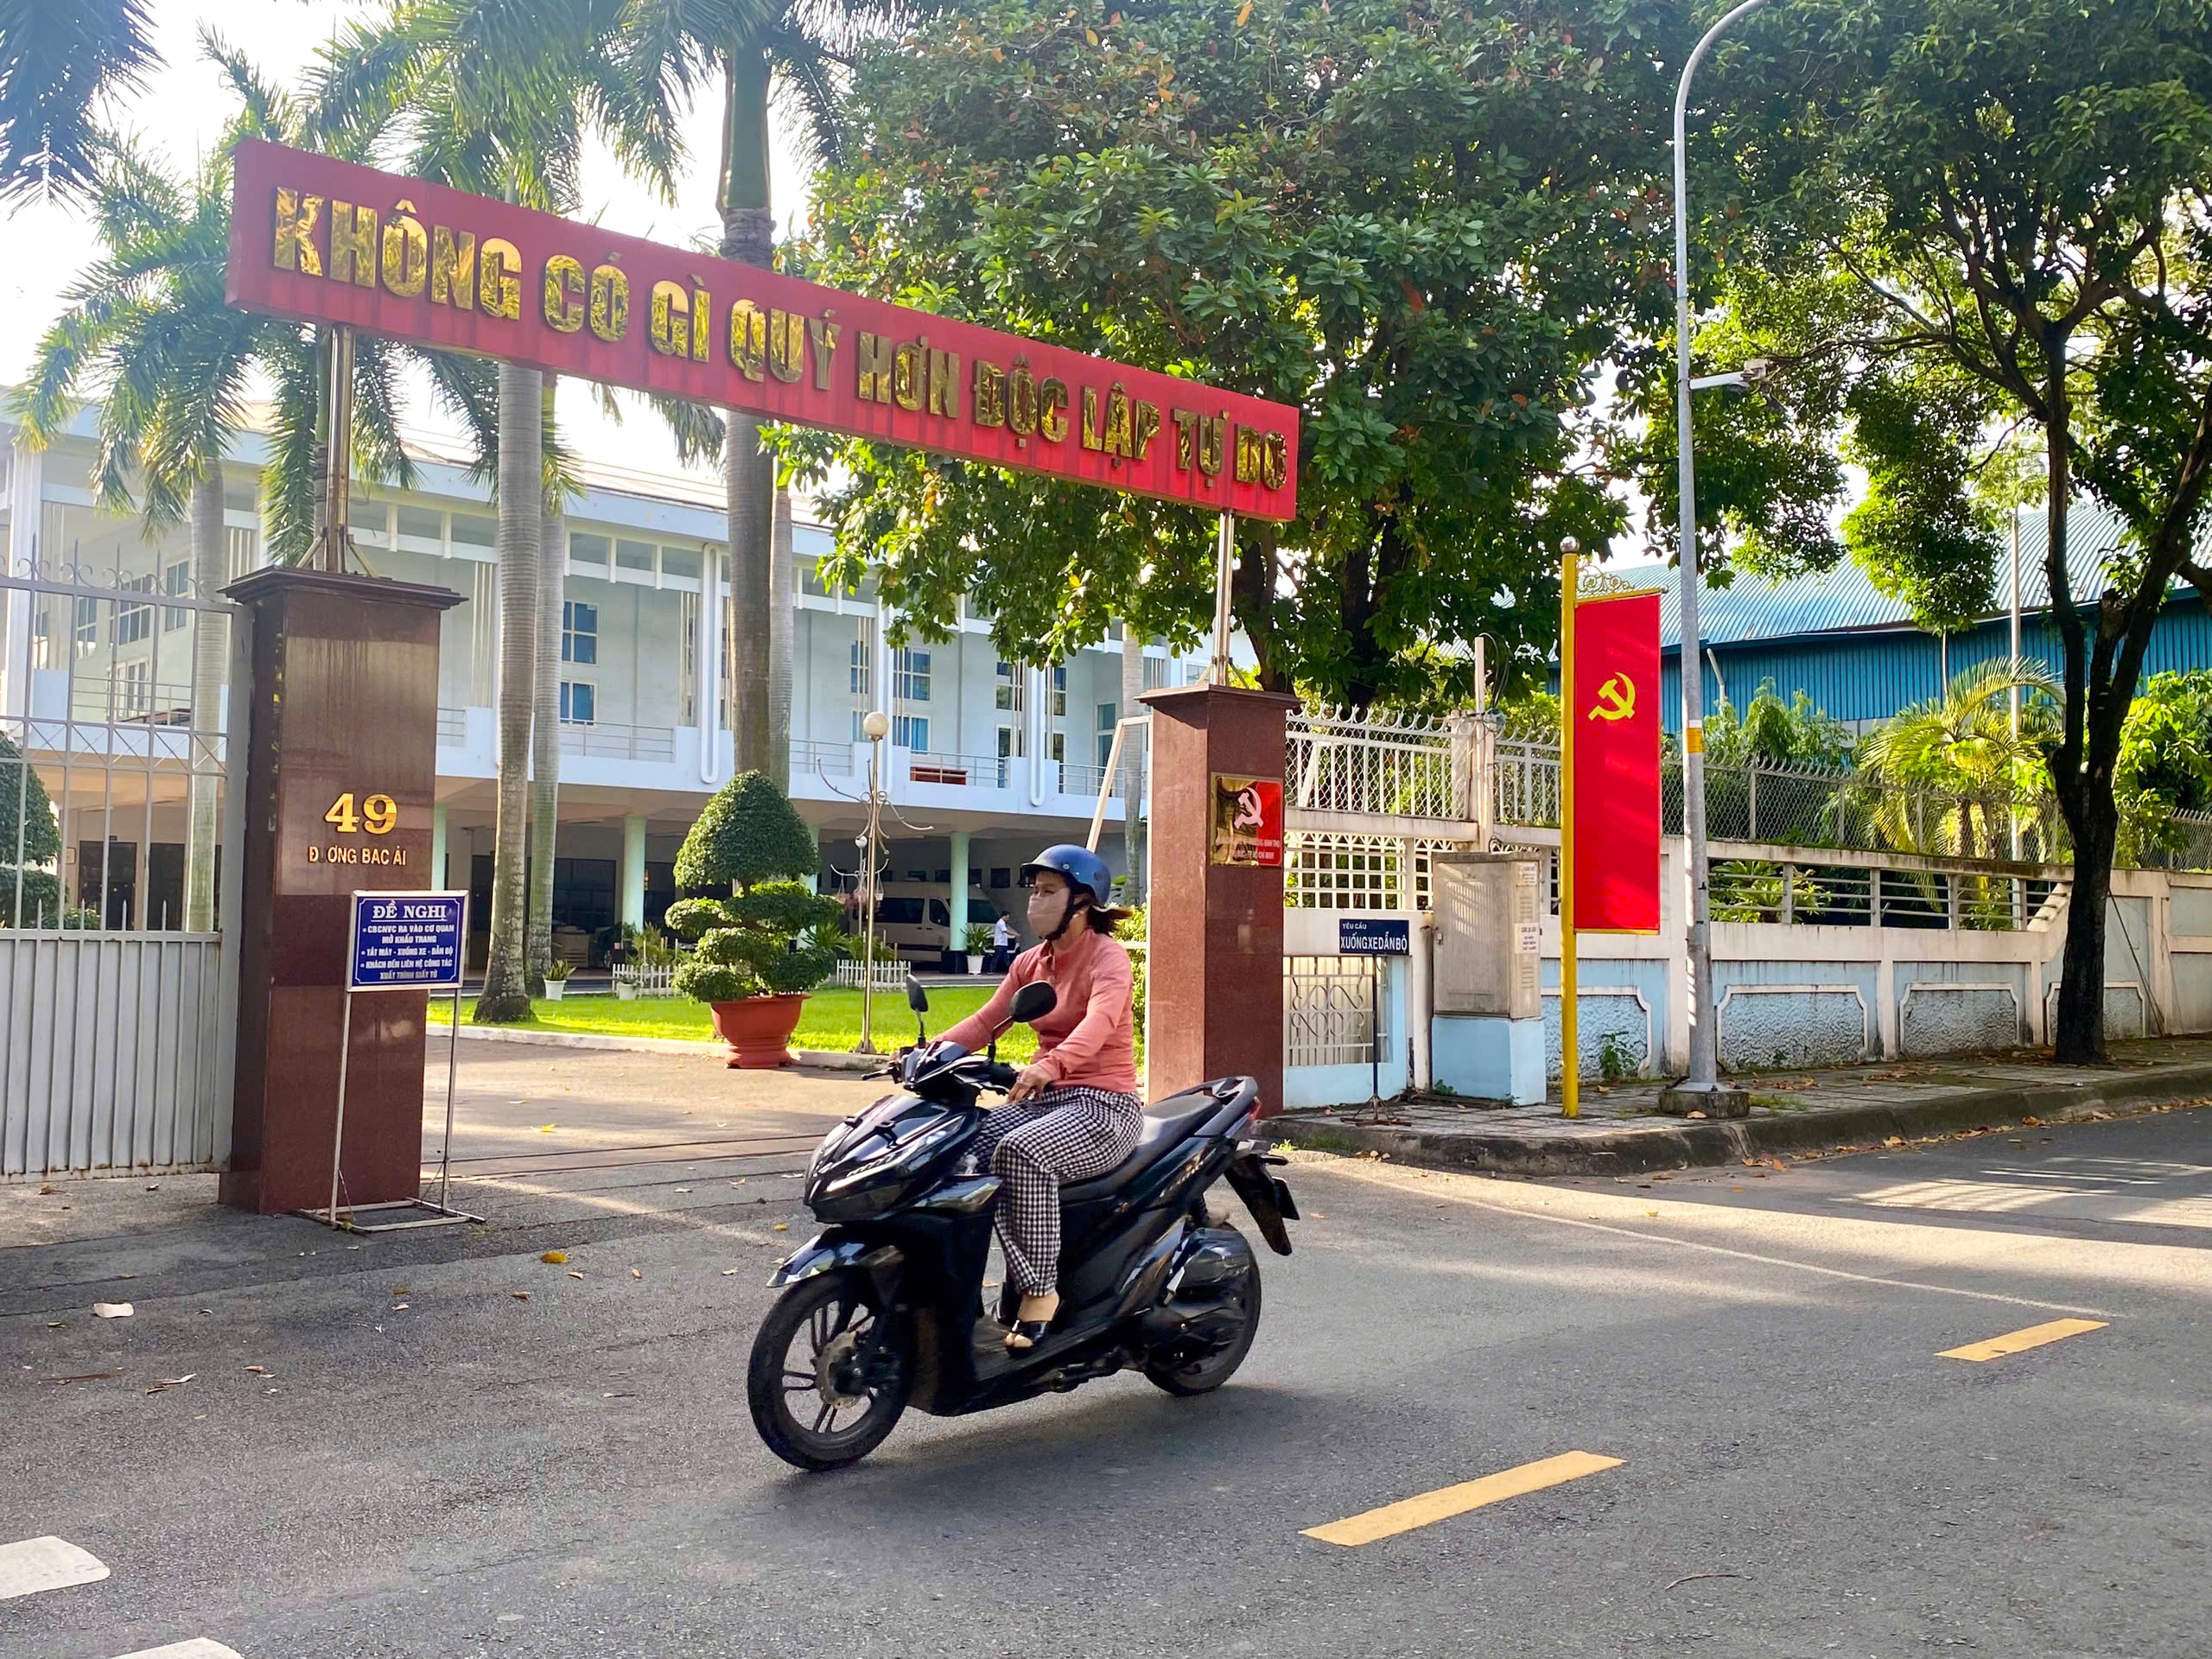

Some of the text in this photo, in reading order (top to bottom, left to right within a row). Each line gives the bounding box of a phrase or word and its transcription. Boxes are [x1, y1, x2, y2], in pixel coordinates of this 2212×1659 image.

[273, 186, 1287, 490] KHÔNG CÓ GÌ QUÝ HƠN ĐỘC LẬP TỰ DO
[324, 792, 397, 835] 49
[403, 905, 447, 921] NGHỊ
